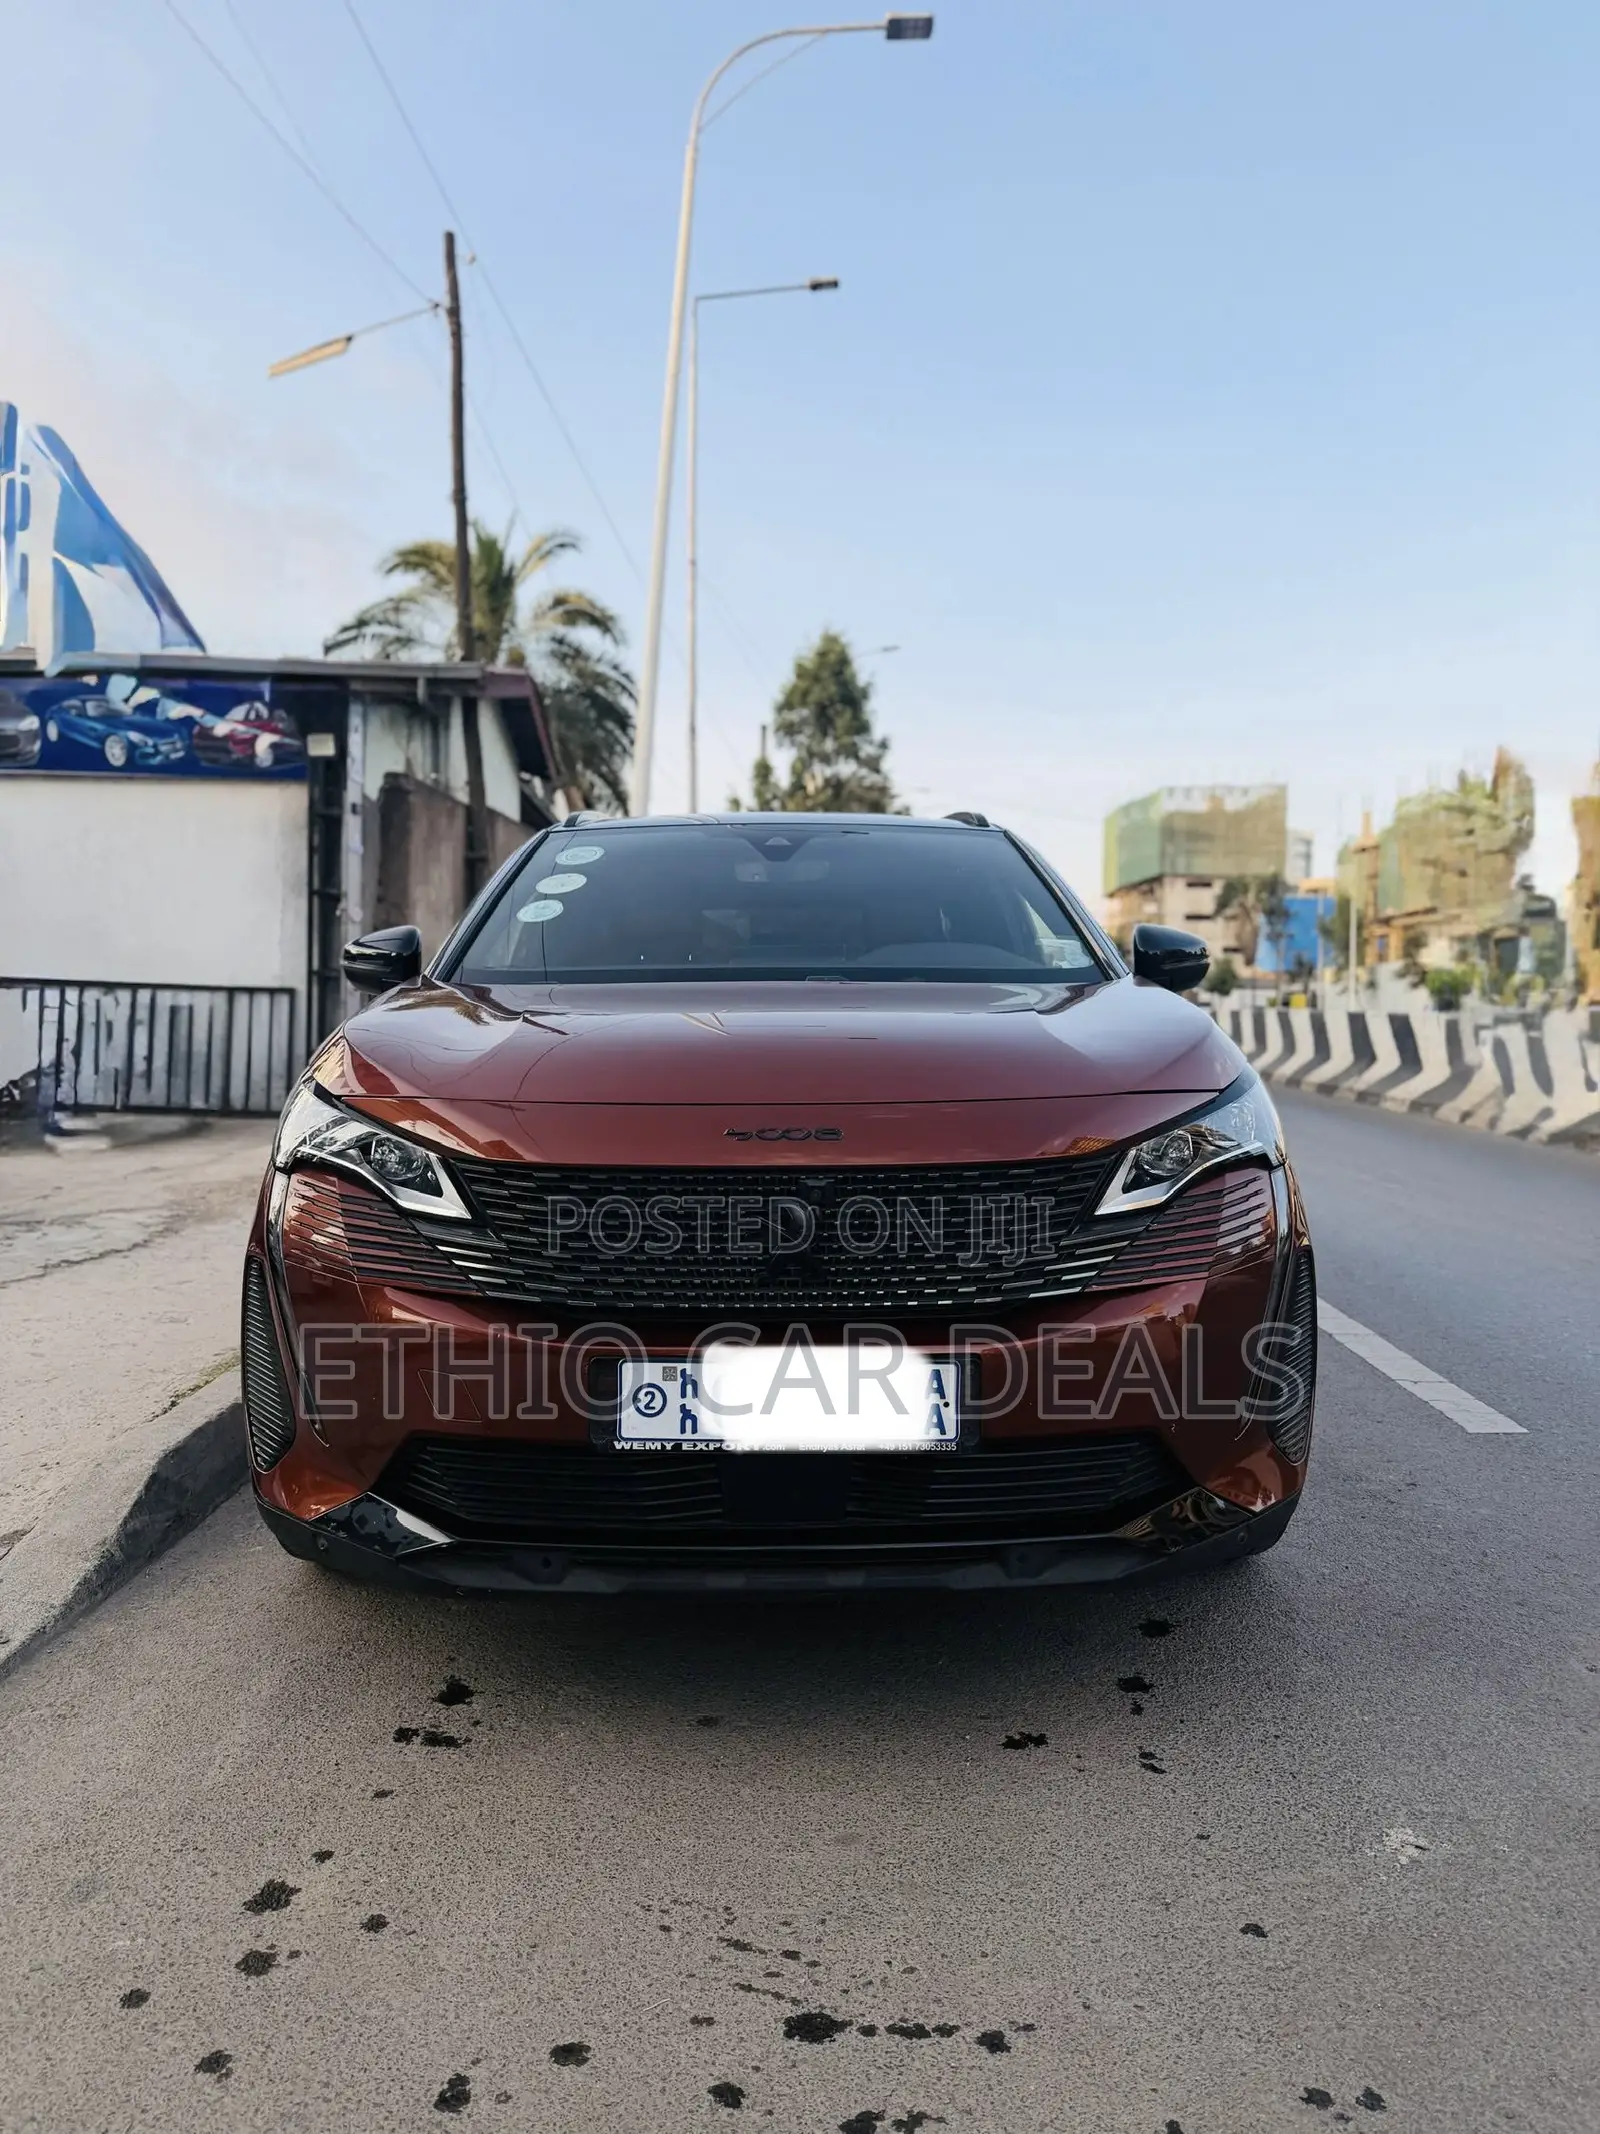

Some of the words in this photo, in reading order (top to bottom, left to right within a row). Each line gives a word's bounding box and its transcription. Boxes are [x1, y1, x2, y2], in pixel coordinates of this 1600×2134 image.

[723, 1128, 844, 1141] 5008
[644, 1390, 656, 1410] 2
[613, 1441, 675, 1450] WEMY
